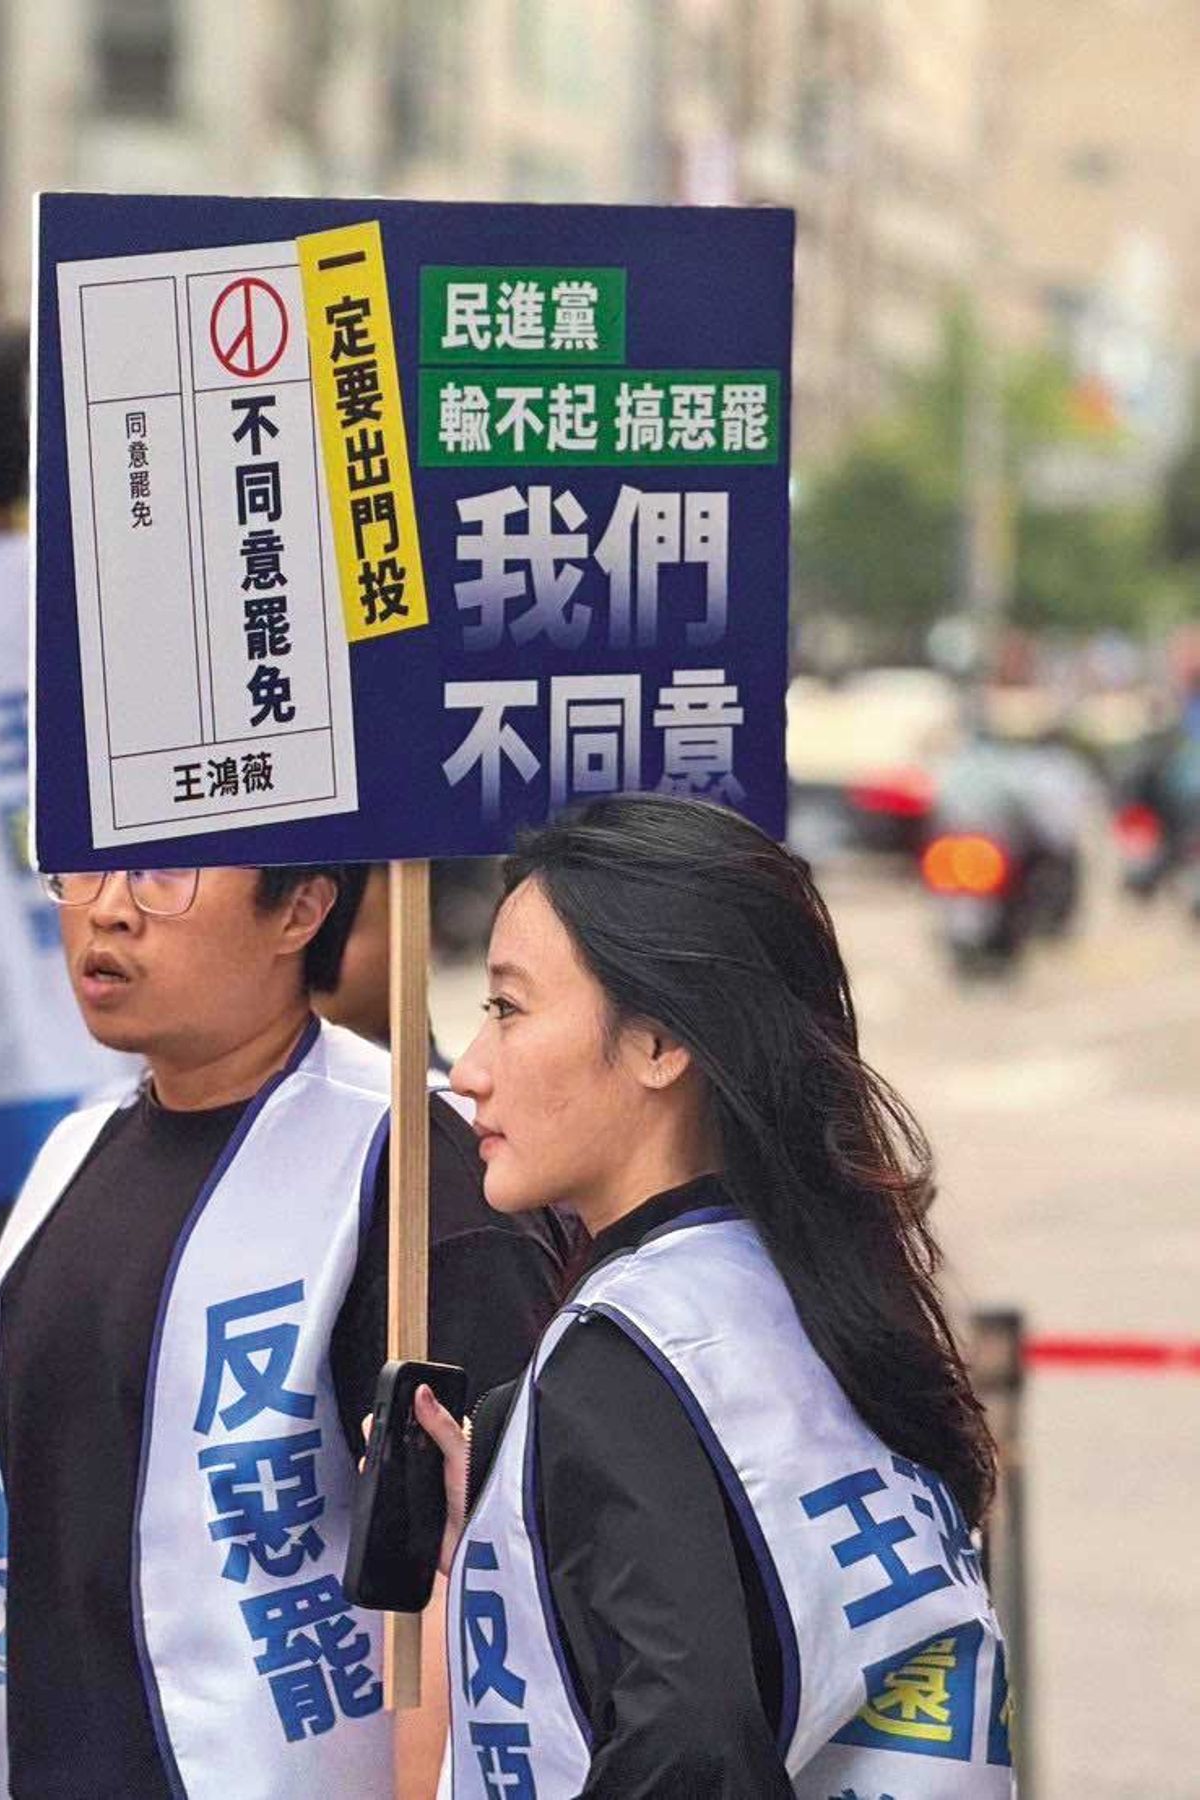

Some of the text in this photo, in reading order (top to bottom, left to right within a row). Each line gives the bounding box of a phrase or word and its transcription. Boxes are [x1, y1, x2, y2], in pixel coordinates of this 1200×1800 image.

[442, 281, 599, 350] 民進黨
[125, 411, 153, 529] 同意罷免
[318, 251, 409, 625] 一定要出門投
[439, 382, 769, 451] 輸不起 搞惡罷
[231, 395, 296, 728] 不同意罷免
[453, 484, 729, 652] 我們
[173, 752, 275, 803] 王鴻薇
[442, 668, 748, 818] 不同意
[194, 1280, 384, 1743] 反惡罷
